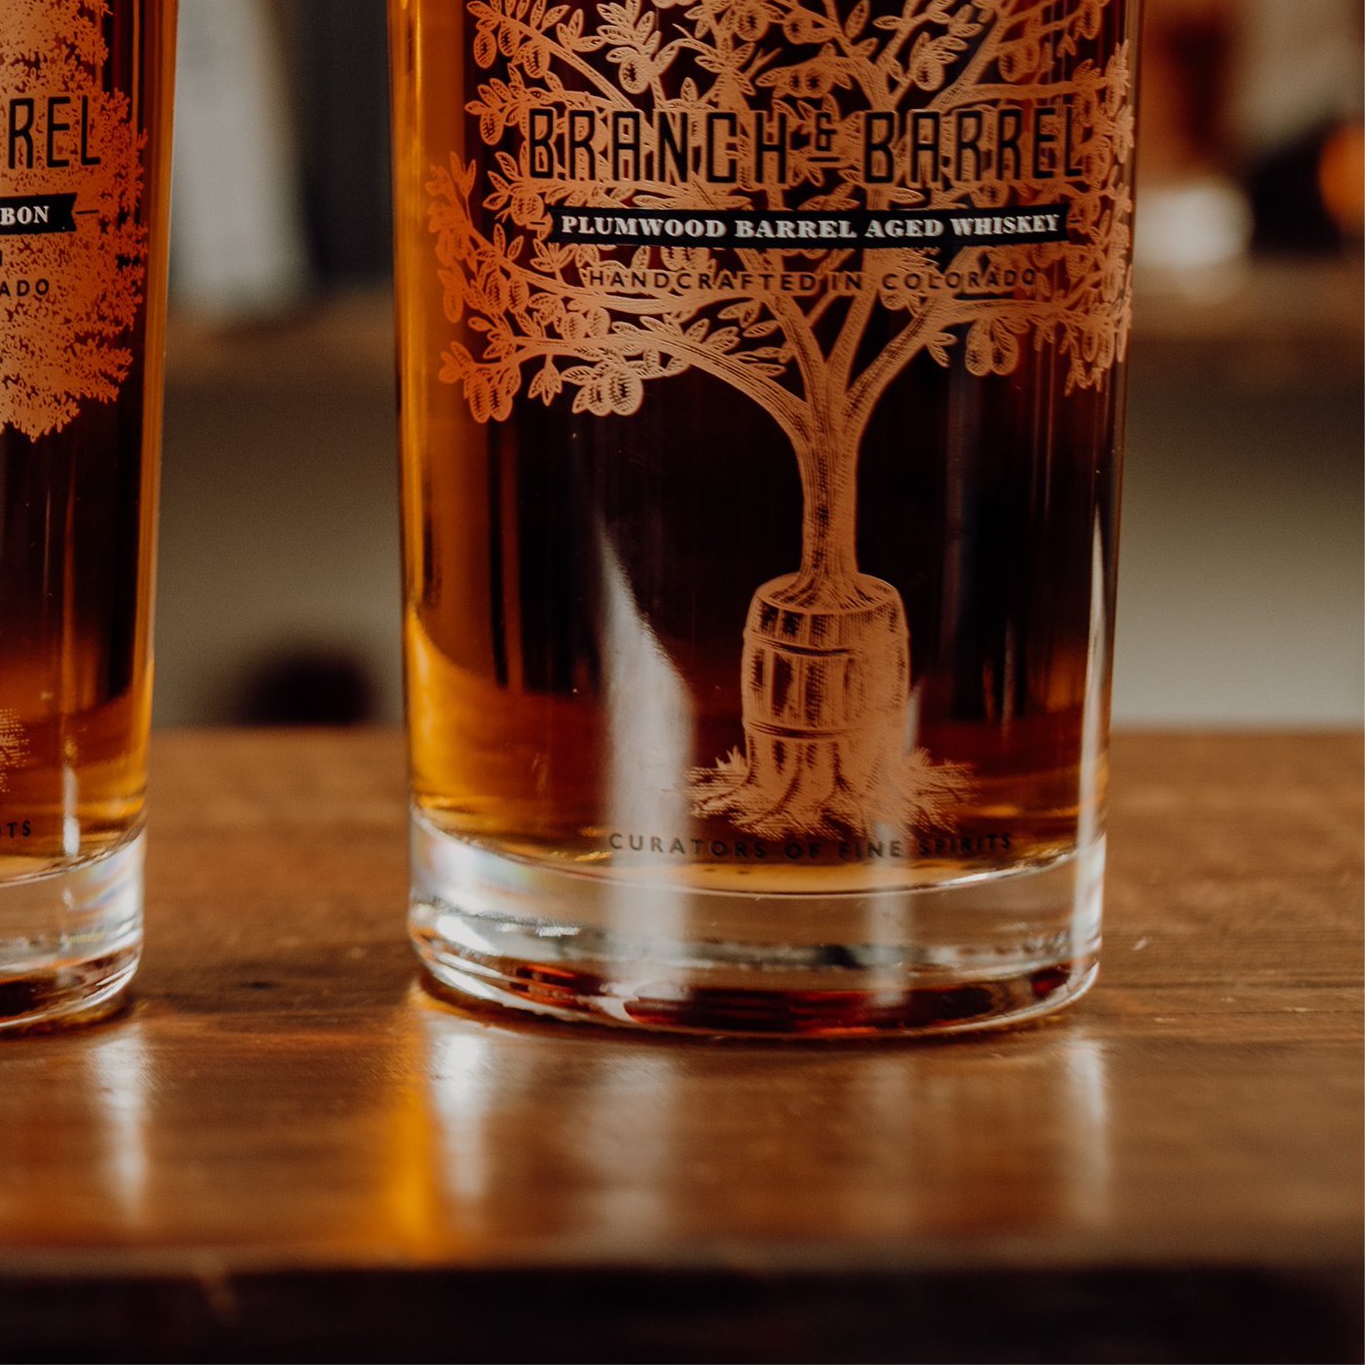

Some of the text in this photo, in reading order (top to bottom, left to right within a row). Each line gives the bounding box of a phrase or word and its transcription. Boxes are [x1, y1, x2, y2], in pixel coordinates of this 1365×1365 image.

[528, 105, 1083, 186] BRANCH & BARREL
[561, 212, 1061, 241] PLUMWOOD BARREL AGED WHISKEY
[589, 266, 1037, 292] HANDCRAFTED IN COLORADO
[607, 833, 1012, 860] CURATORS OF FINE SPIRITS
